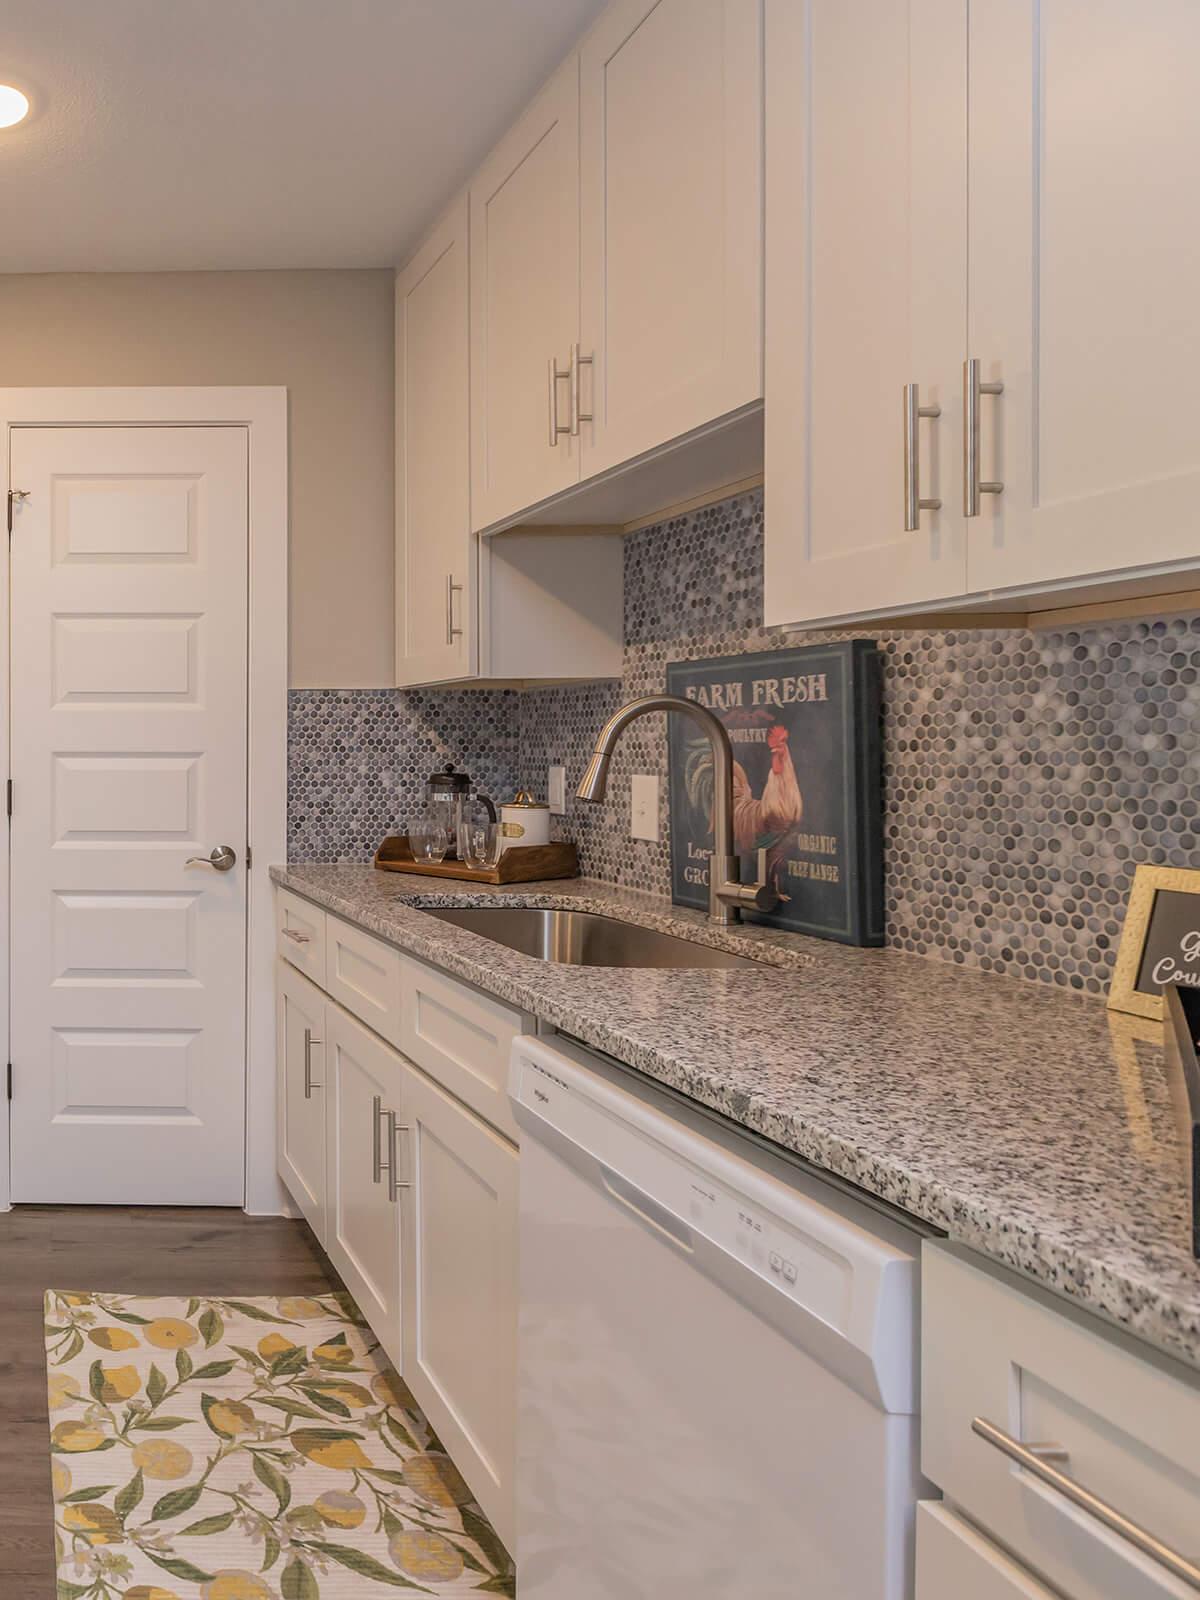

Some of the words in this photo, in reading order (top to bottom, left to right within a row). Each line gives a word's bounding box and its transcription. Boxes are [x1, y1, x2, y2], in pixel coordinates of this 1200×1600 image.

[685, 682, 744, 712] FARM
[751, 673, 829, 708] FRESH
[798, 833, 837, 855] ORGANIC
[684, 866, 710, 887] GRO
[1152, 956, 1200, 986] Cou
